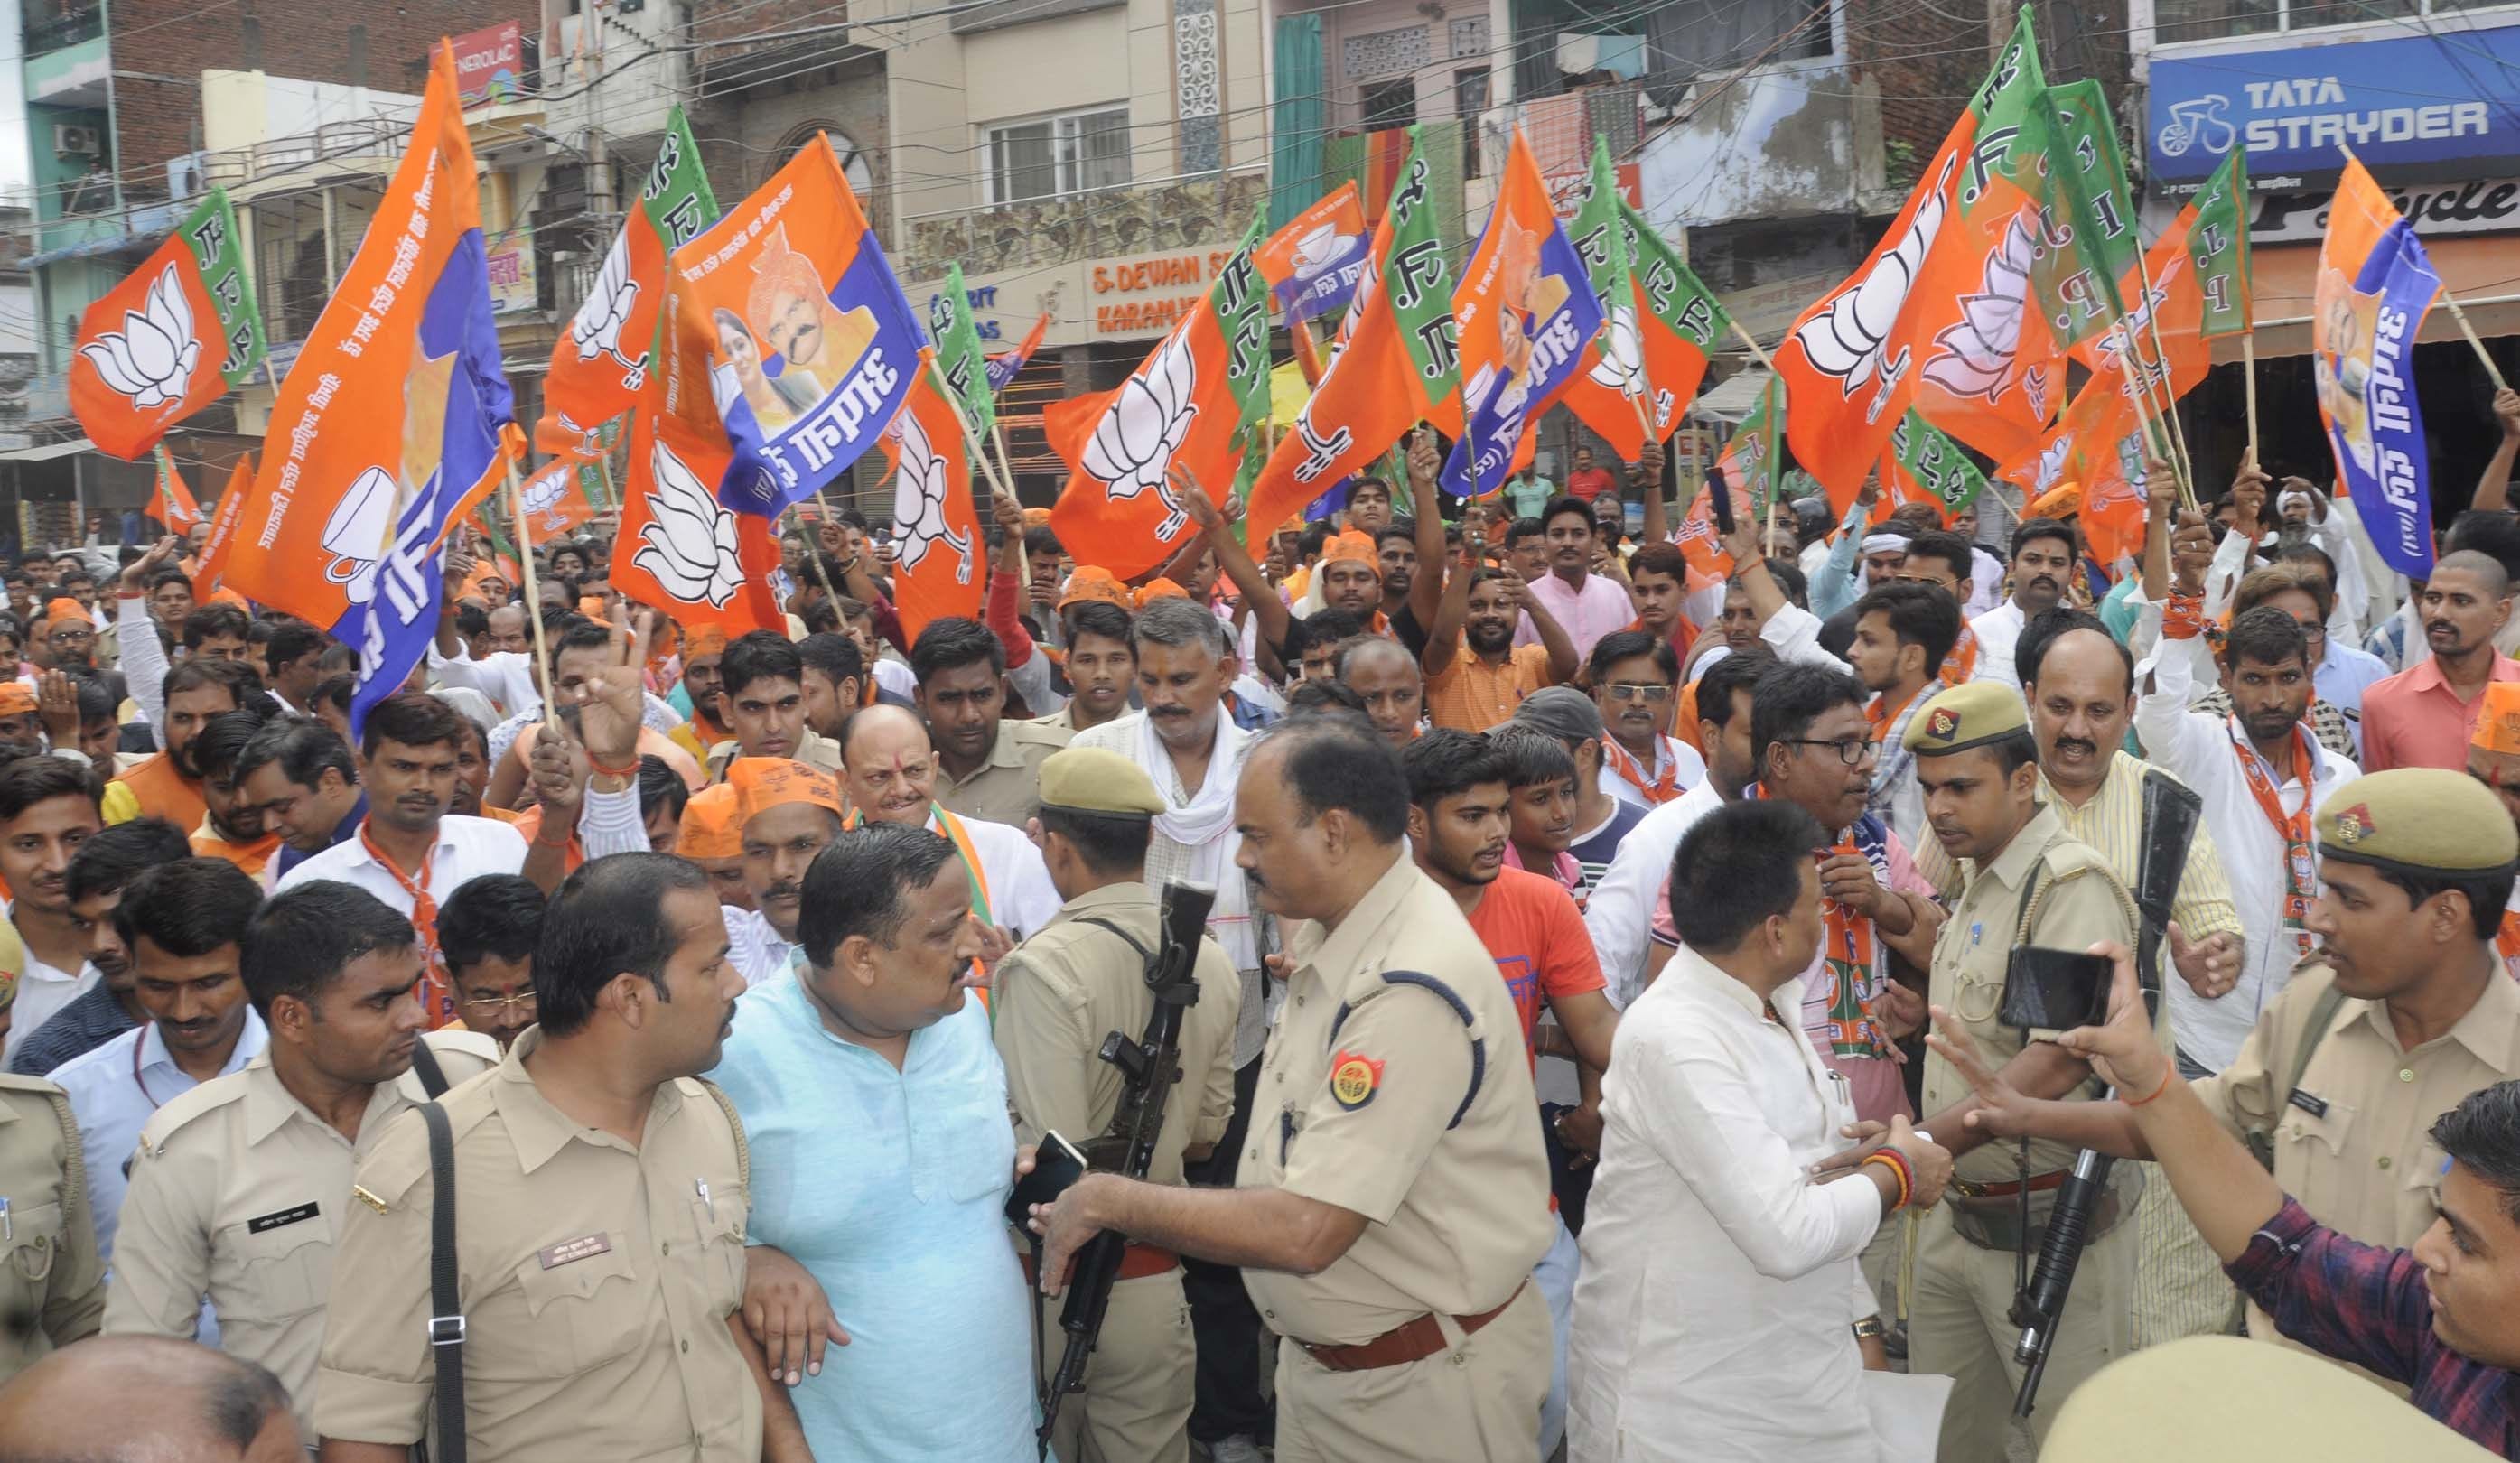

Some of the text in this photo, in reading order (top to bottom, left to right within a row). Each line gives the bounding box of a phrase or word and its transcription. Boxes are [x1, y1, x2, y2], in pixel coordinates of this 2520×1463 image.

[457, 43, 515, 74] NEROLAC
[2245, 76, 2346, 110] TATA
[2245, 101, 2489, 153] STRYDER
